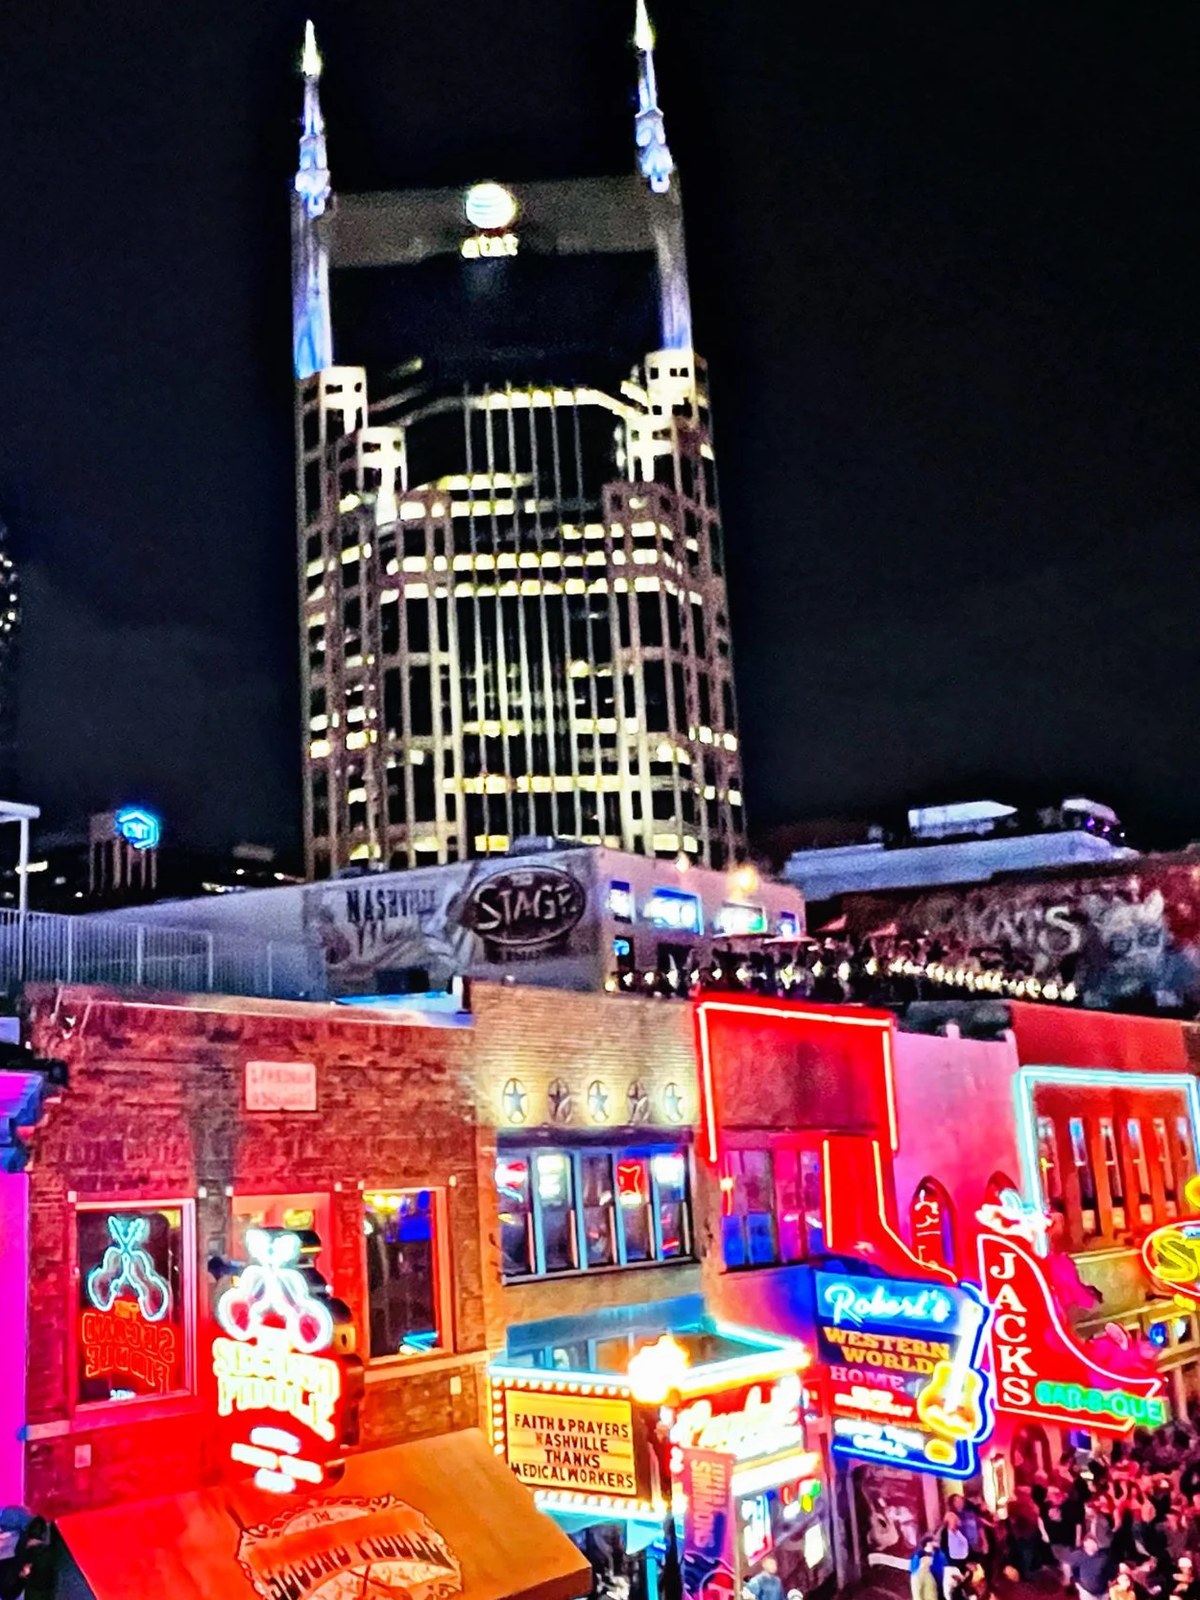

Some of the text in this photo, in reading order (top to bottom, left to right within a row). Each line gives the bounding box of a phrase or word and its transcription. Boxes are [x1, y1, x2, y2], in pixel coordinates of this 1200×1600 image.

[824, 1283, 951, 1327] Robert's
[990, 1252, 1037, 1405] JACKS
[823, 1326, 950, 1359] WESTERN
[841, 1346, 934, 1374] WORLD
[829, 1365, 905, 1392] HOME
[514, 1413, 554, 1430] FAITH
[568, 1419, 629, 1438] PRAYERS
[535, 1431, 609, 1453] NASHVILLE
[545, 1449, 600, 1469] THANKS
[511, 1462, 634, 1488] MEDICAL WORKERS
